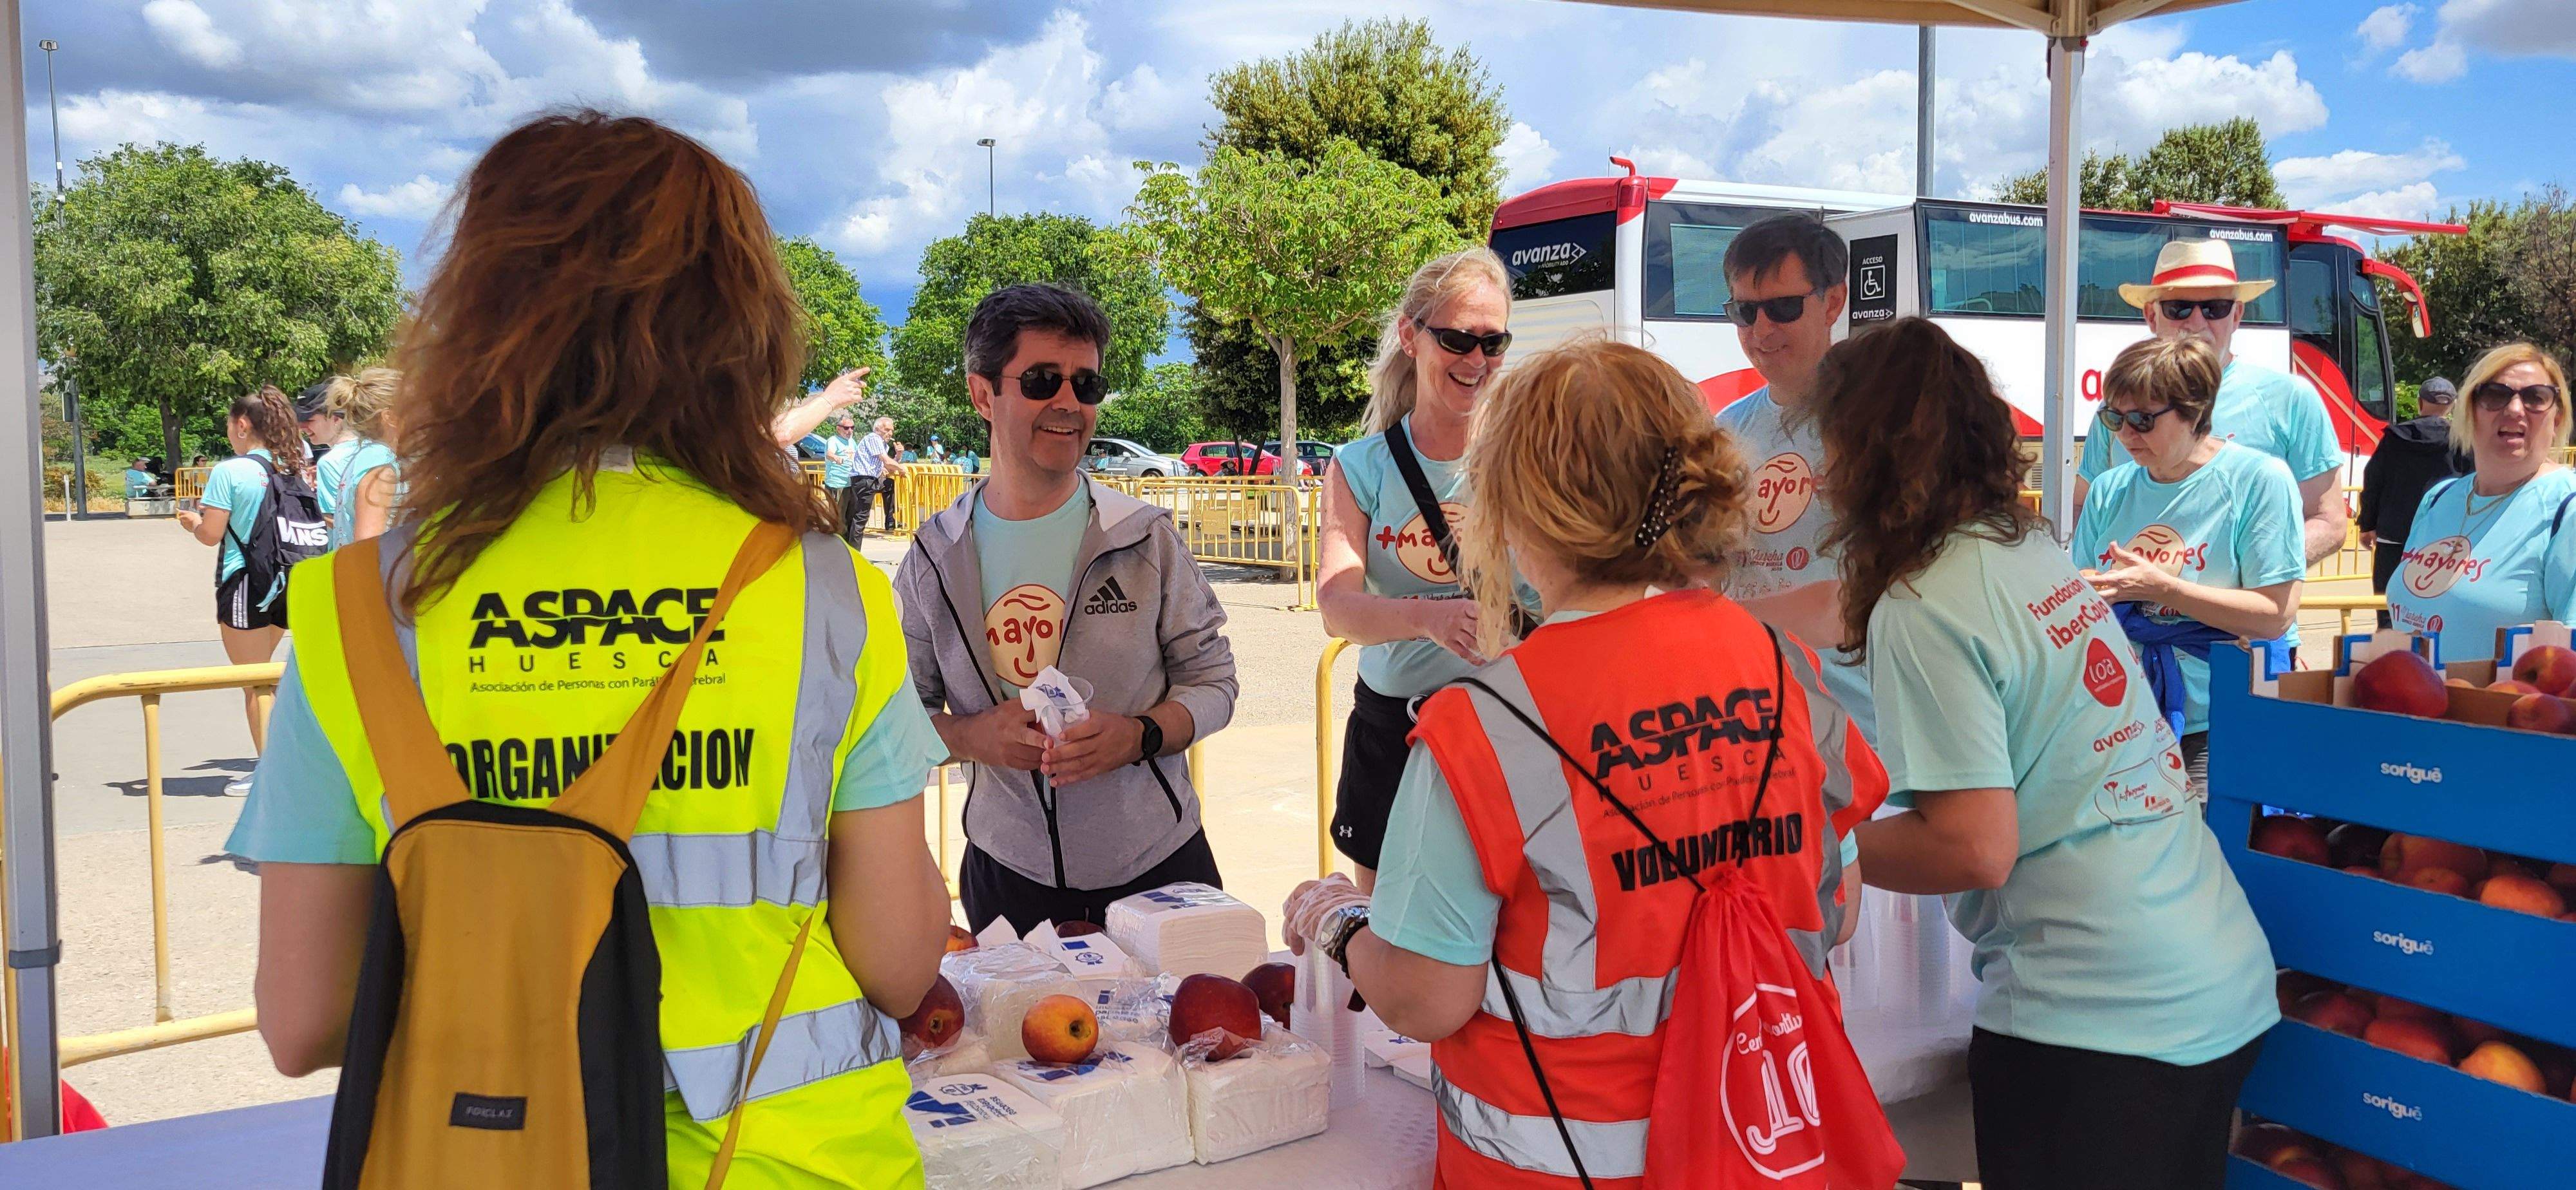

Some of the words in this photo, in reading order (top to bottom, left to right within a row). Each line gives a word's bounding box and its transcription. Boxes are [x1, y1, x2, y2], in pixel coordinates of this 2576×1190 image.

[1969, 211, 2043, 227] avanzabus.com
[2210, 229, 2273, 242] avanzabus.com
[1512, 243, 1571, 266] avanza
[1862, 256, 1883, 265] ACCESO
[1852, 309, 1884, 319] avanza
[276, 516, 328, 546] VANS
[468, 587, 725, 649] ASPACE
[1084, 599, 1137, 616] adidas
[468, 648, 719, 674] HUESCA
[469, 681, 536, 694] Asociación
[539, 680, 555, 691] de
[557, 679, 605, 691] Personas
[608, 679, 629, 689] con
[692, 673, 726, 685] rebral
[1591, 687, 1784, 779] ASPACE
[1611, 813, 1802, 892] VOLUNTARIO
